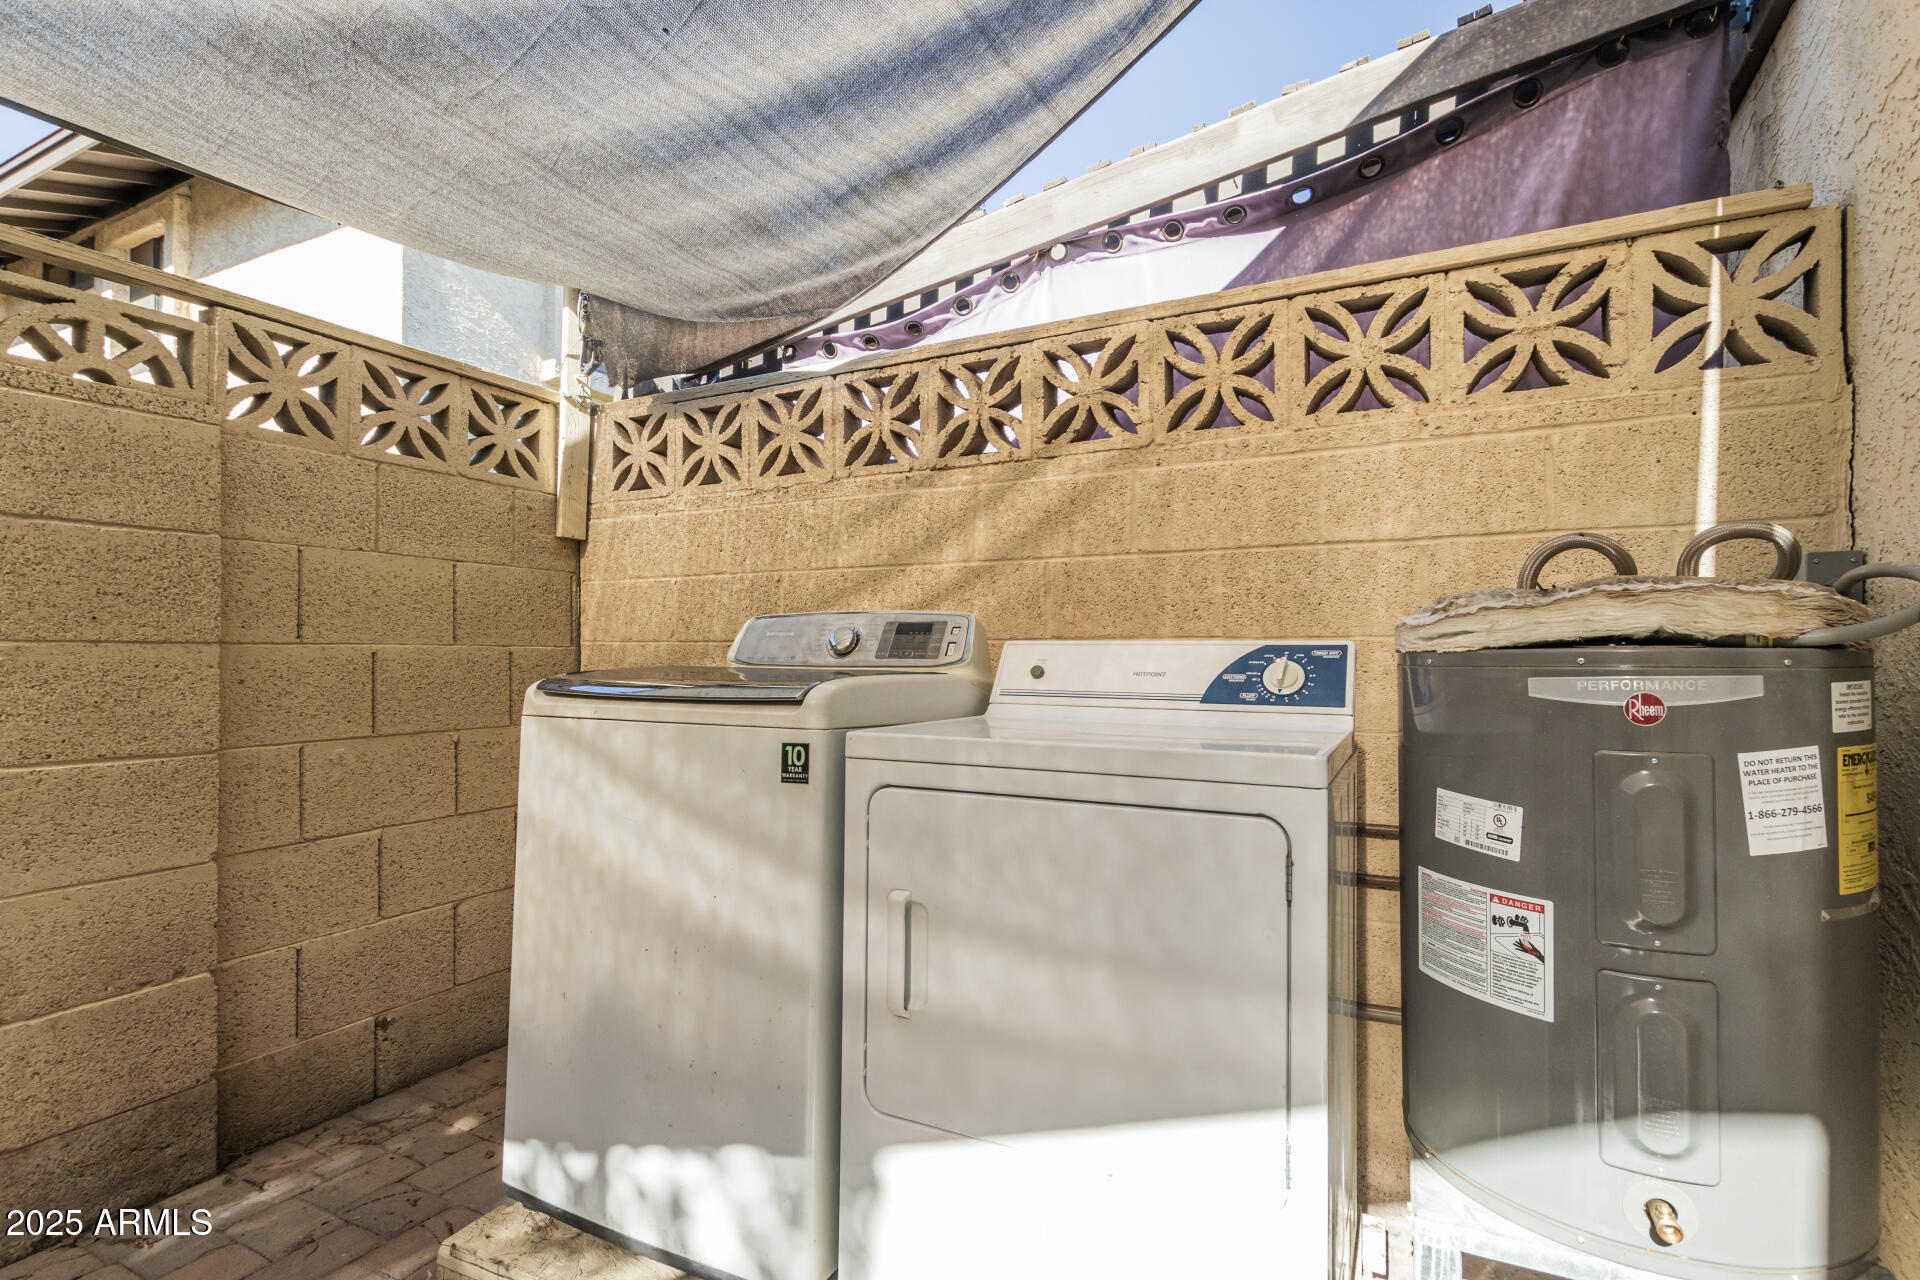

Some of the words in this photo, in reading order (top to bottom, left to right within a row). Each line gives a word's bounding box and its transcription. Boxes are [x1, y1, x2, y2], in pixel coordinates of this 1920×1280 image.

[1576, 680, 1708, 691] PERFORMANCE
[1628, 693, 1664, 721] Rheem
[785, 745, 805, 766] 10
[1758, 758, 1773, 766] NOT
[1775, 755, 1802, 764] RETURN
[1803, 753, 1817, 761] THIS
[1743, 768, 1770, 777] WATER
[1771, 765, 1797, 774] HEATER
[1807, 762, 1819, 770] THE
[1748, 778, 1771, 787] PLACE
[1772, 777, 1782, 785] OF
[1783, 773, 1817, 783] PURCHASE
[1748, 803, 1823, 820] 1-866-279-4566
[1501, 897, 1542, 912] DANGER
